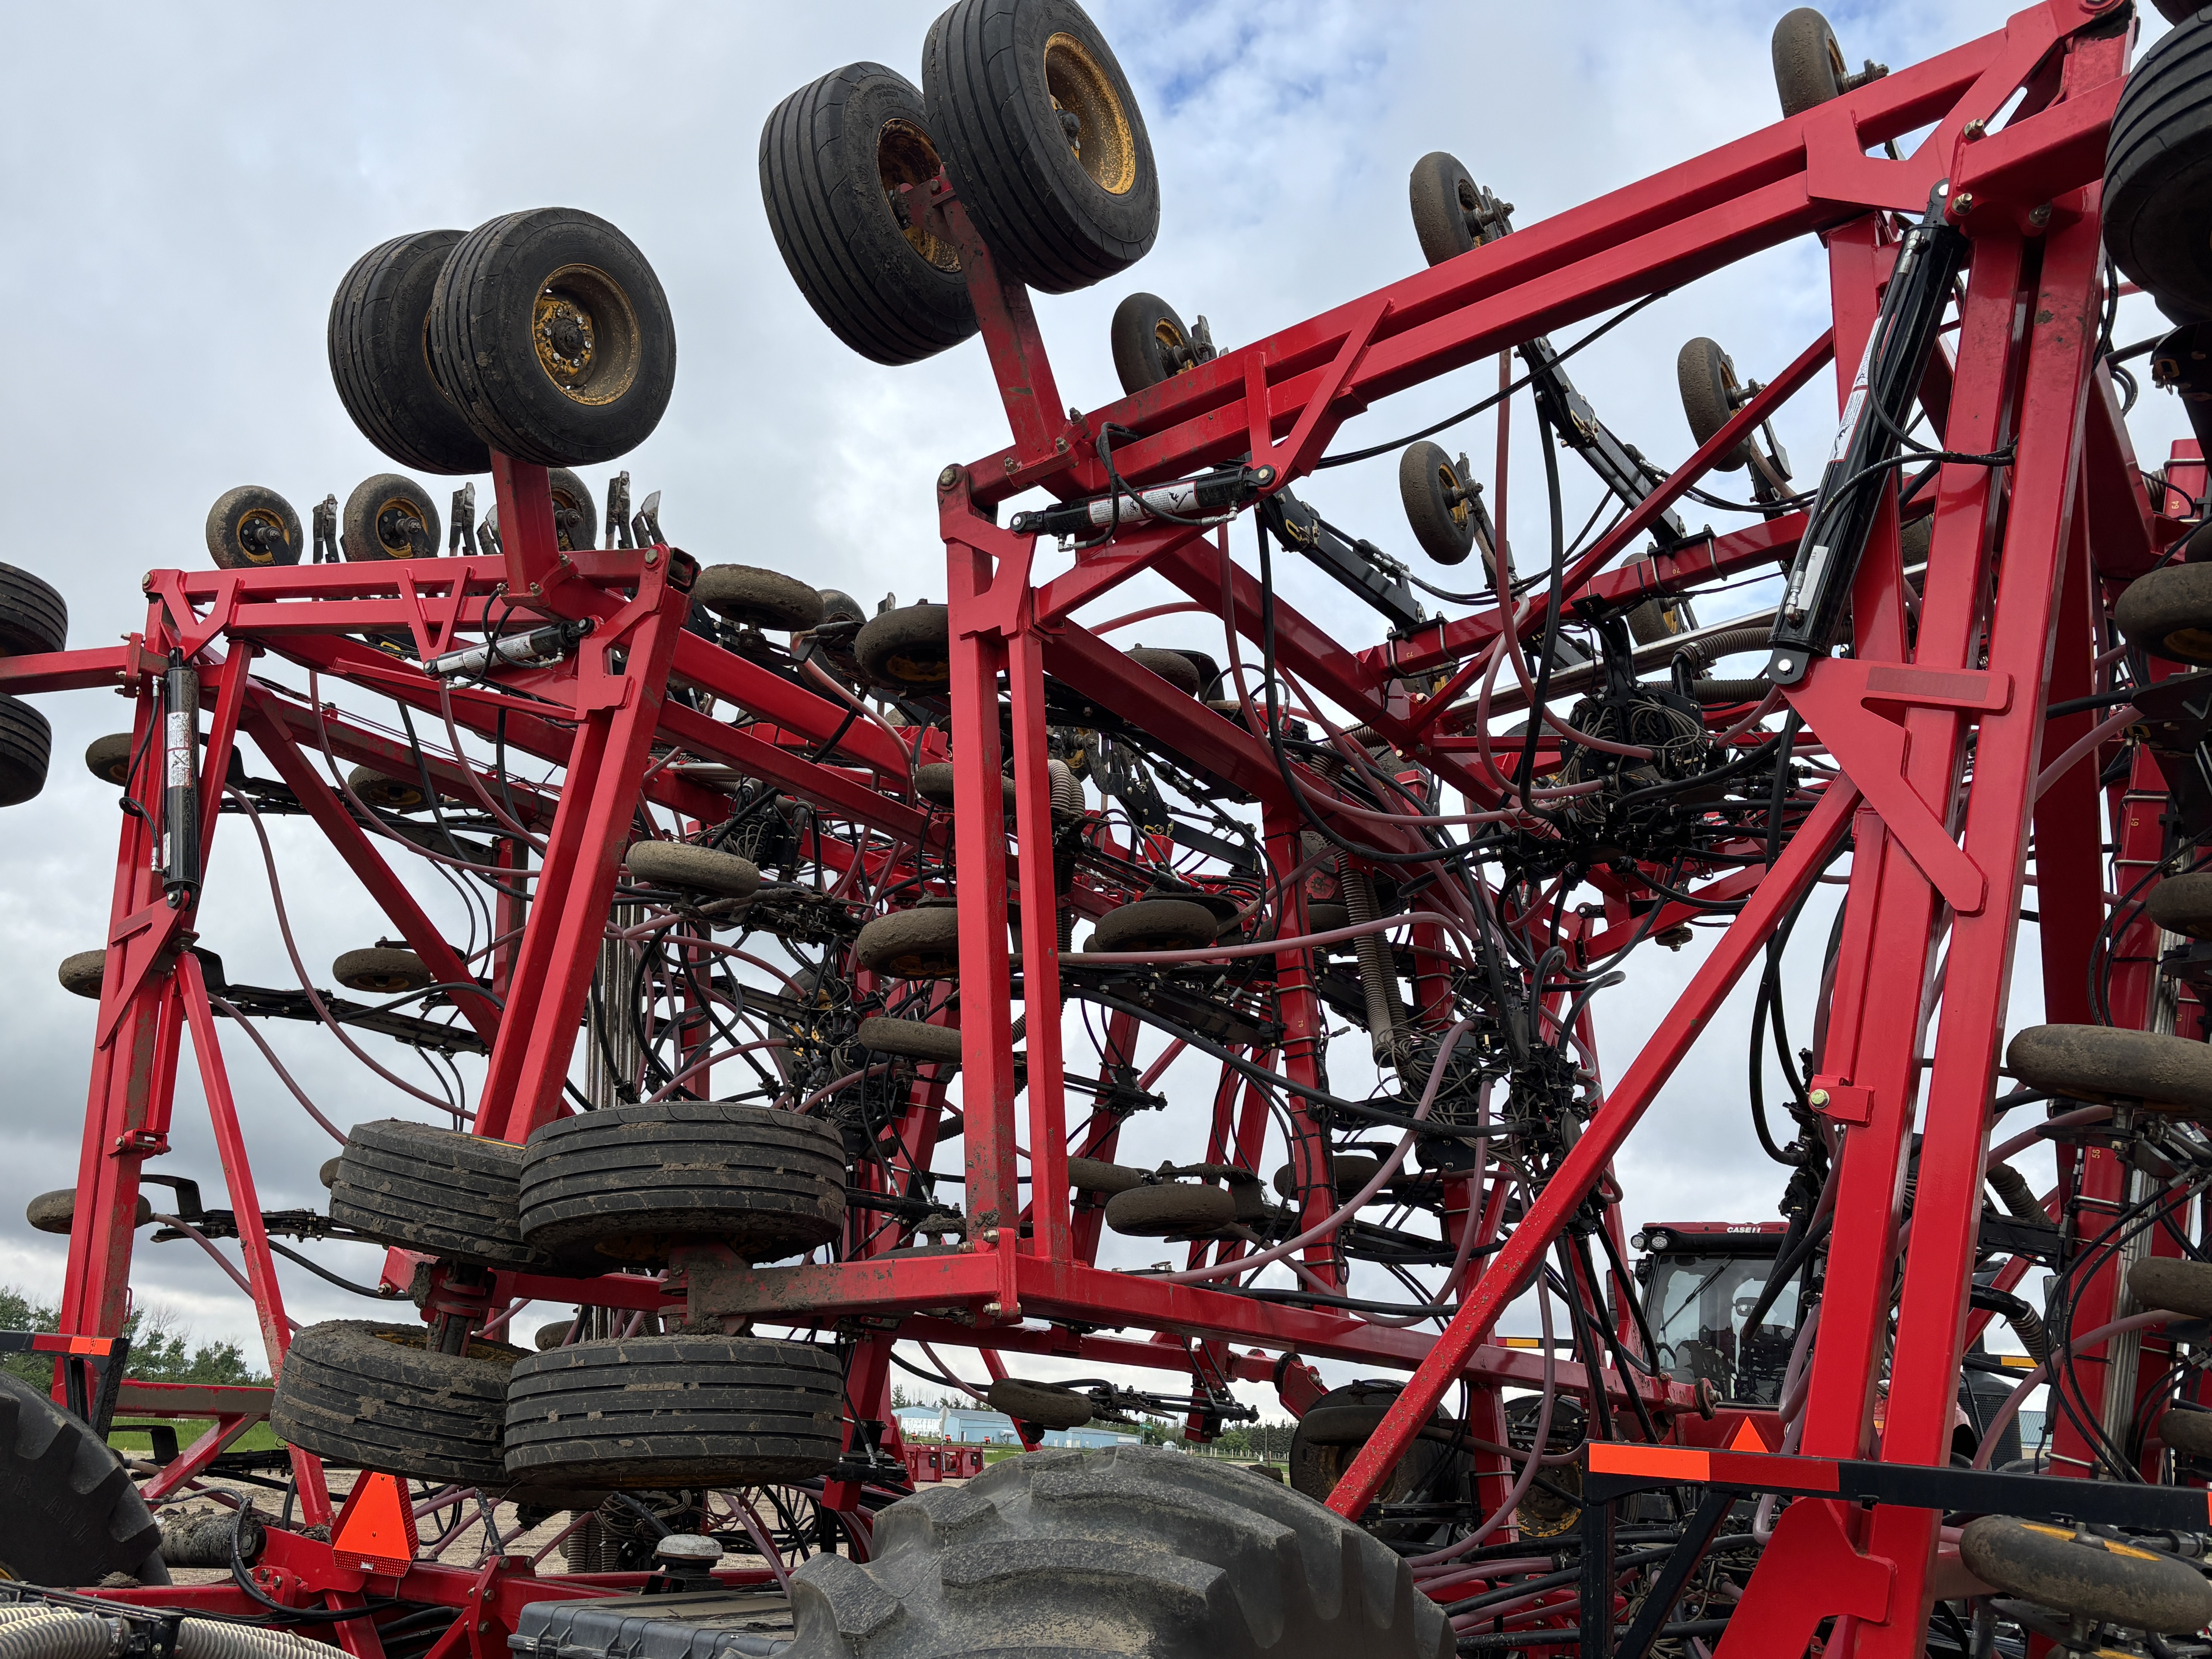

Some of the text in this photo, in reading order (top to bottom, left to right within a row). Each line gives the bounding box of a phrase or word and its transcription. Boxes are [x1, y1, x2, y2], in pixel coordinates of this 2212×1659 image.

[2171, 501, 2179, 509] 64
[2131, 818, 2140, 826] 61
[1298, 1019, 1304, 1028] 79
[2092, 1149, 2100, 1159] 58
